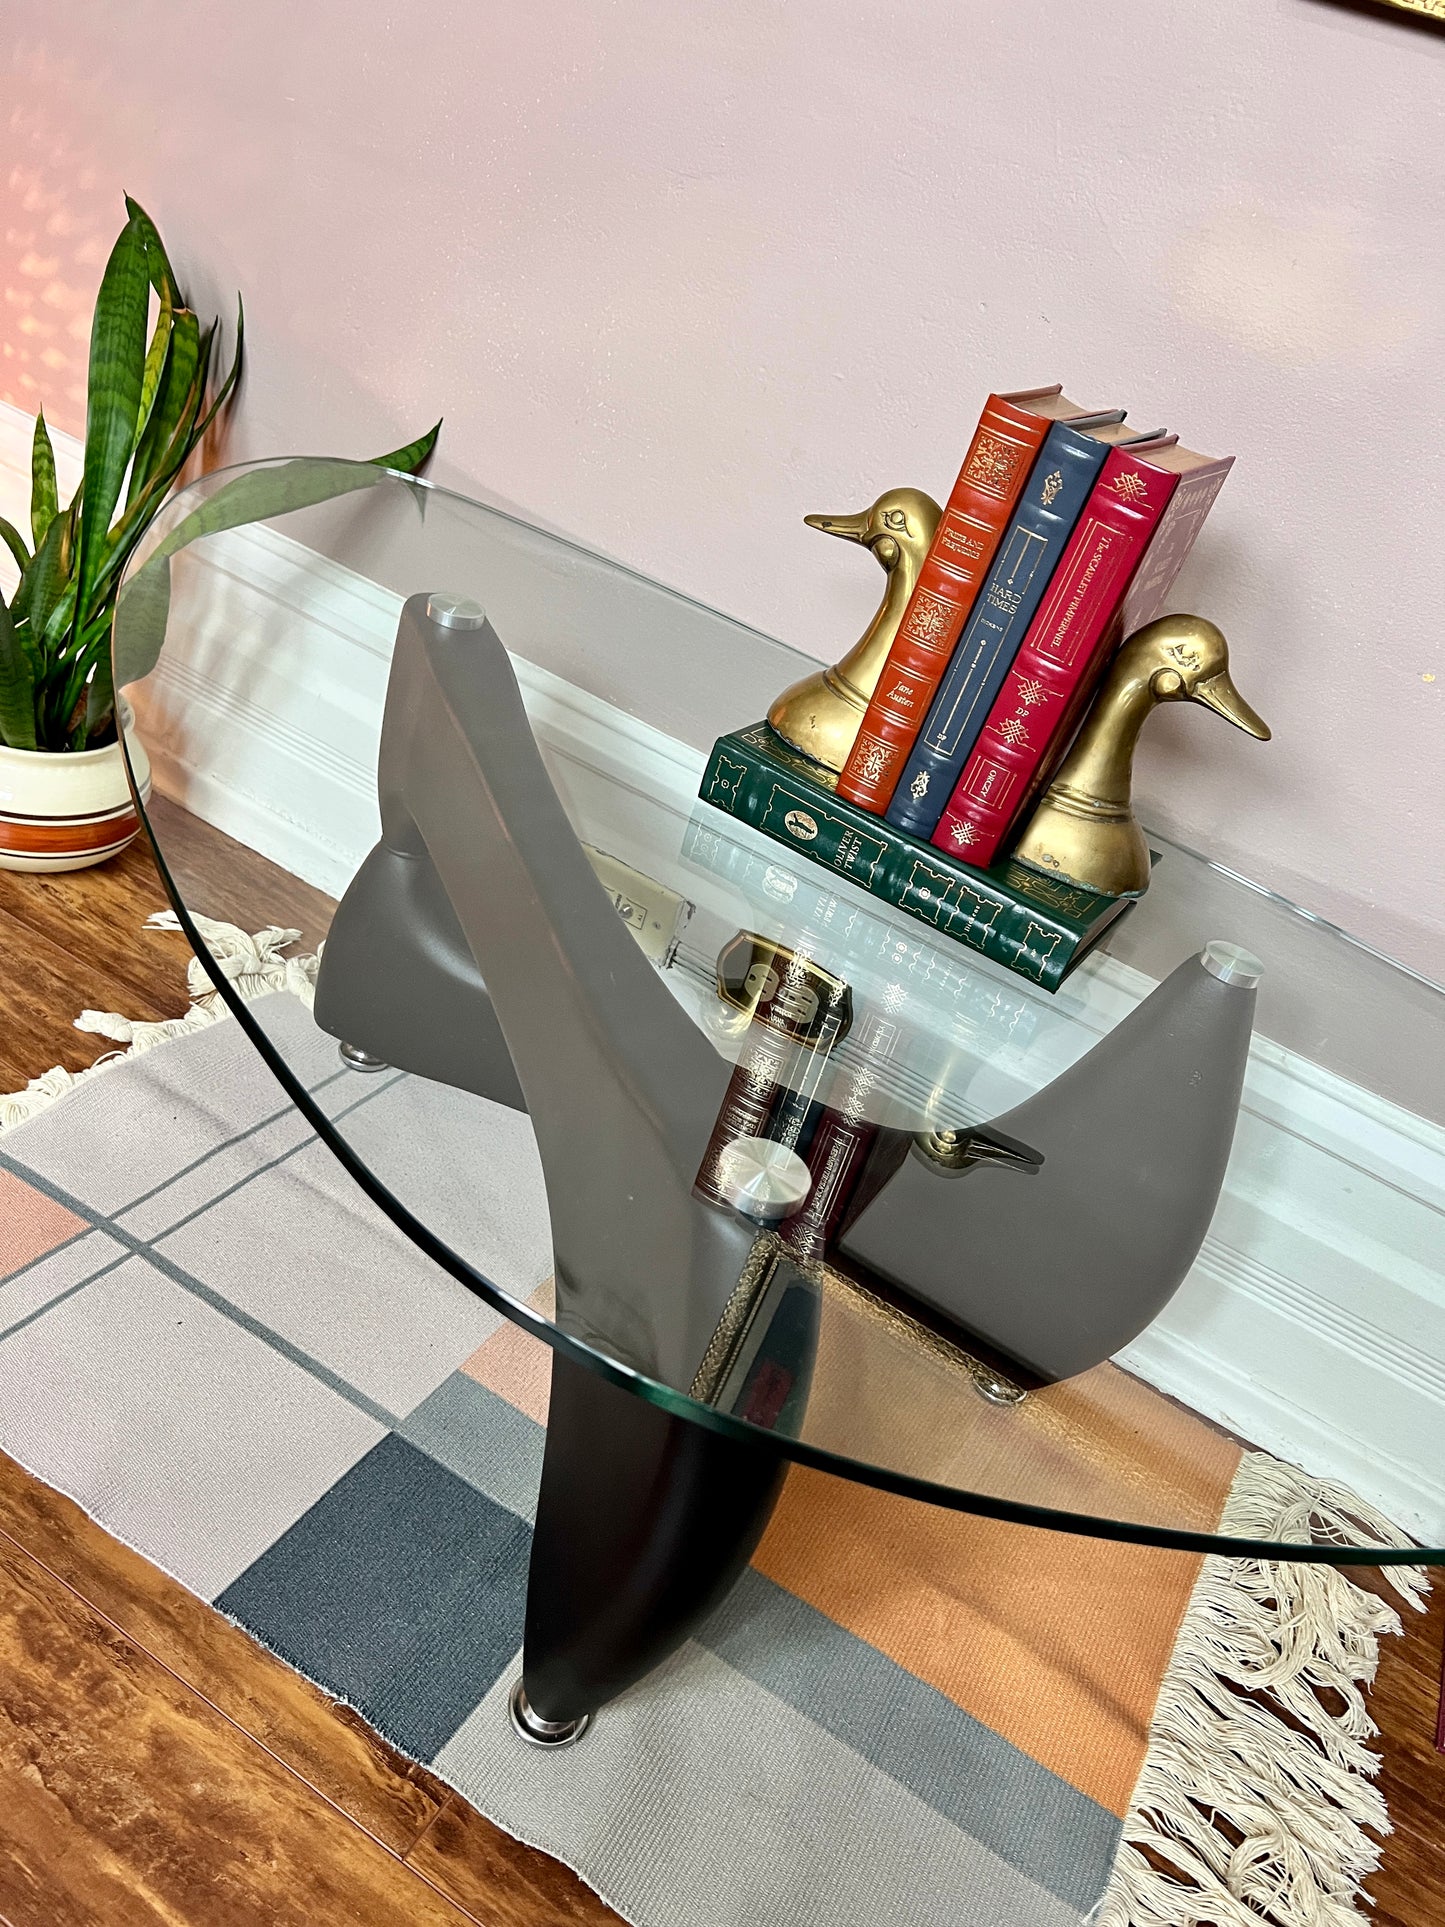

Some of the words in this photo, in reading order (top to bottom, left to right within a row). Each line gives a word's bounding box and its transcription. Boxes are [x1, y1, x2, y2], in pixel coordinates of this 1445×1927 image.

[941, 536, 980, 559] PREJUDICE
[944, 527, 967, 543] PRIDE
[966, 539, 984, 550] AND
[1096, 536, 1112, 553] The
[1076, 552, 1102, 597] SCARLET
[987, 593, 1018, 614] TIMES
[990, 582, 1022, 604] HARD
[1050, 596, 1082, 647] PIMPERNEL
[886, 690, 914, 708] Austen
[893, 681, 914, 695] Jane
[1015, 706, 1030, 717] DP
[980, 770, 997, 797] ORCZY
[833, 830, 854, 867] OLIVER
[843, 837, 862, 869] TWIST
[964, 905, 981, 932] Dickens
